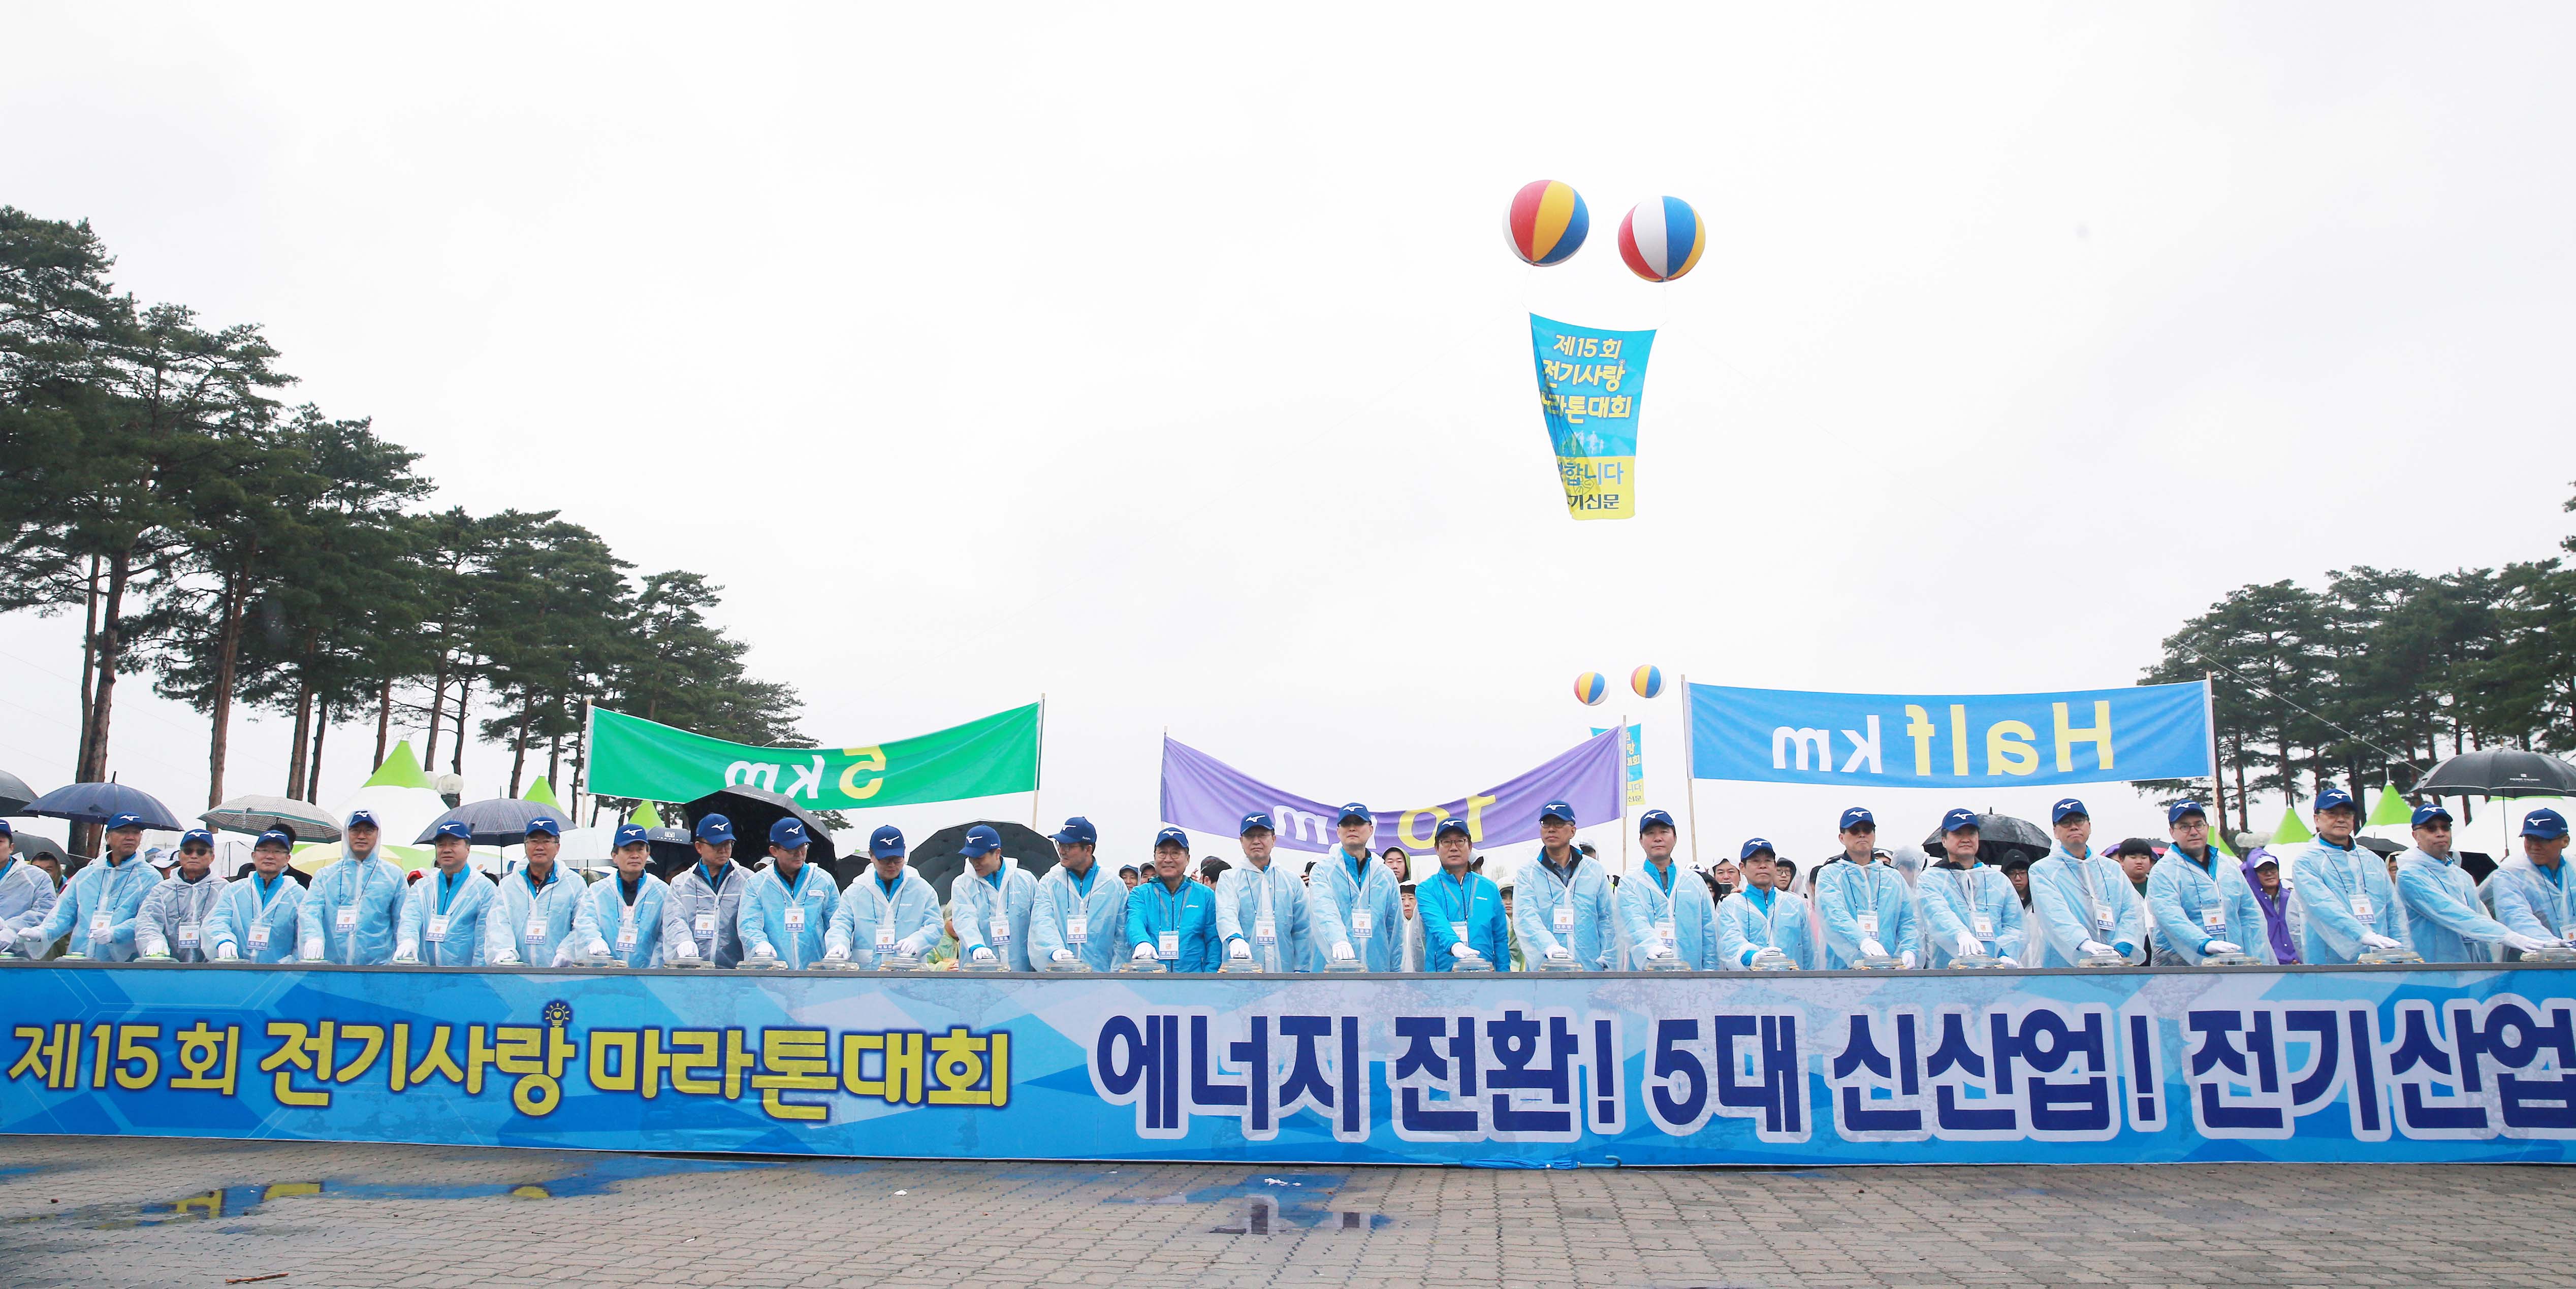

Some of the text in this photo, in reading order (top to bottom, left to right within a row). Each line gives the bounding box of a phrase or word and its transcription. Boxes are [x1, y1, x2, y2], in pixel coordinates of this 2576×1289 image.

[1096, 1004, 2576, 1133] 에너지 전환! 5대 신산업! 전기산업
